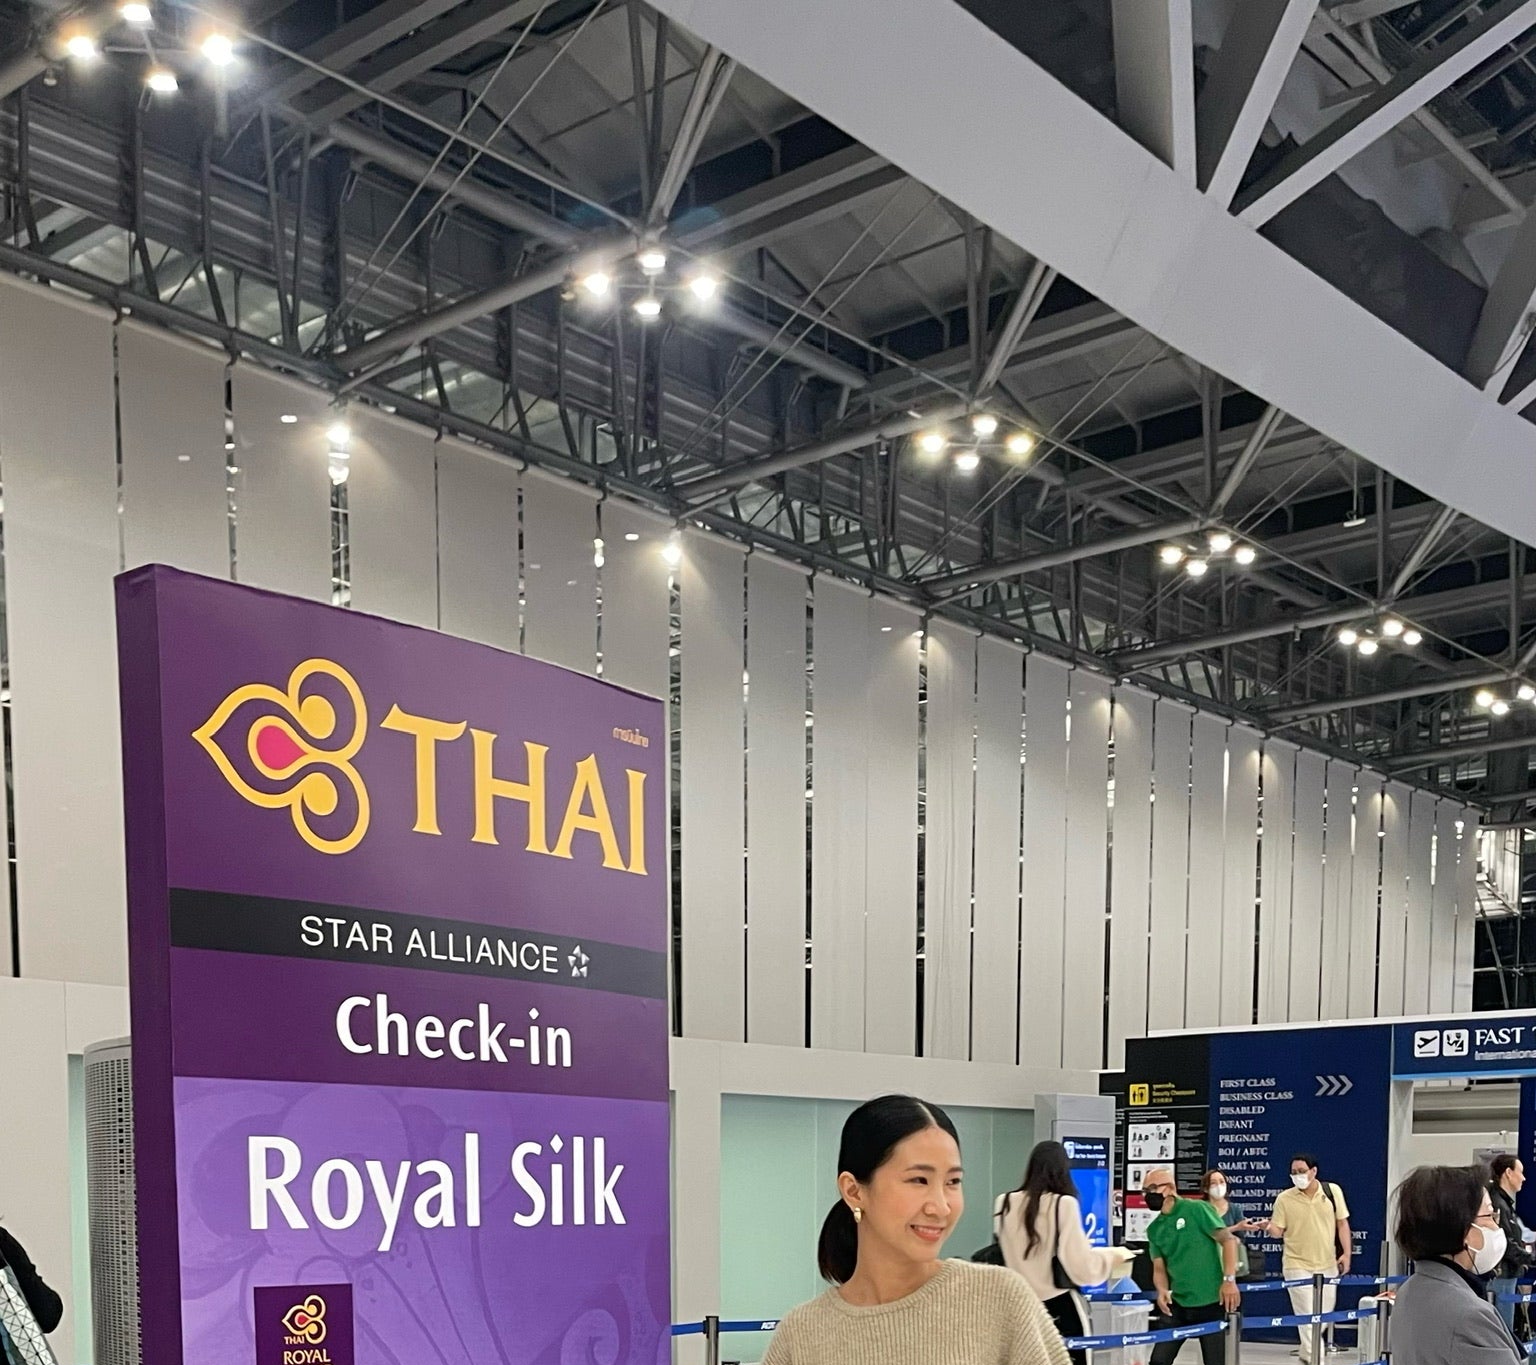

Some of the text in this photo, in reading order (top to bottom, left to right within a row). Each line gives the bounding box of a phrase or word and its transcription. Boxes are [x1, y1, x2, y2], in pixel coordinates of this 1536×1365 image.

[380, 703, 648, 876] THAI
[301, 915, 559, 973] STAR ALLIANCE
[336, 993, 572, 1068] Check-in
[1474, 1027, 1525, 1045] FAST
[1474, 1049, 1536, 1061] Internationa
[1220, 1077, 1276, 1088] FIRST CLASS
[1219, 1091, 1294, 1101] BUSINESS CLASS
[1219, 1105, 1265, 1115] DISABLED
[1219, 1119, 1254, 1129] INFANT
[1218, 1133, 1270, 1143] PREGNANT
[1218, 1147, 1235, 1156] BOI
[1217, 1161, 1271, 1171] SMART VISA
[1225, 1175, 1266, 1184] ONG STAY
[248, 1132, 627, 1252] Royal Silk
[1229, 1189, 1265, 1198] AILAND
[1261, 1244, 1283, 1252] SERV
[284, 1336, 305, 1345] THAI
[283, 1348, 331, 1365] ROYAL
